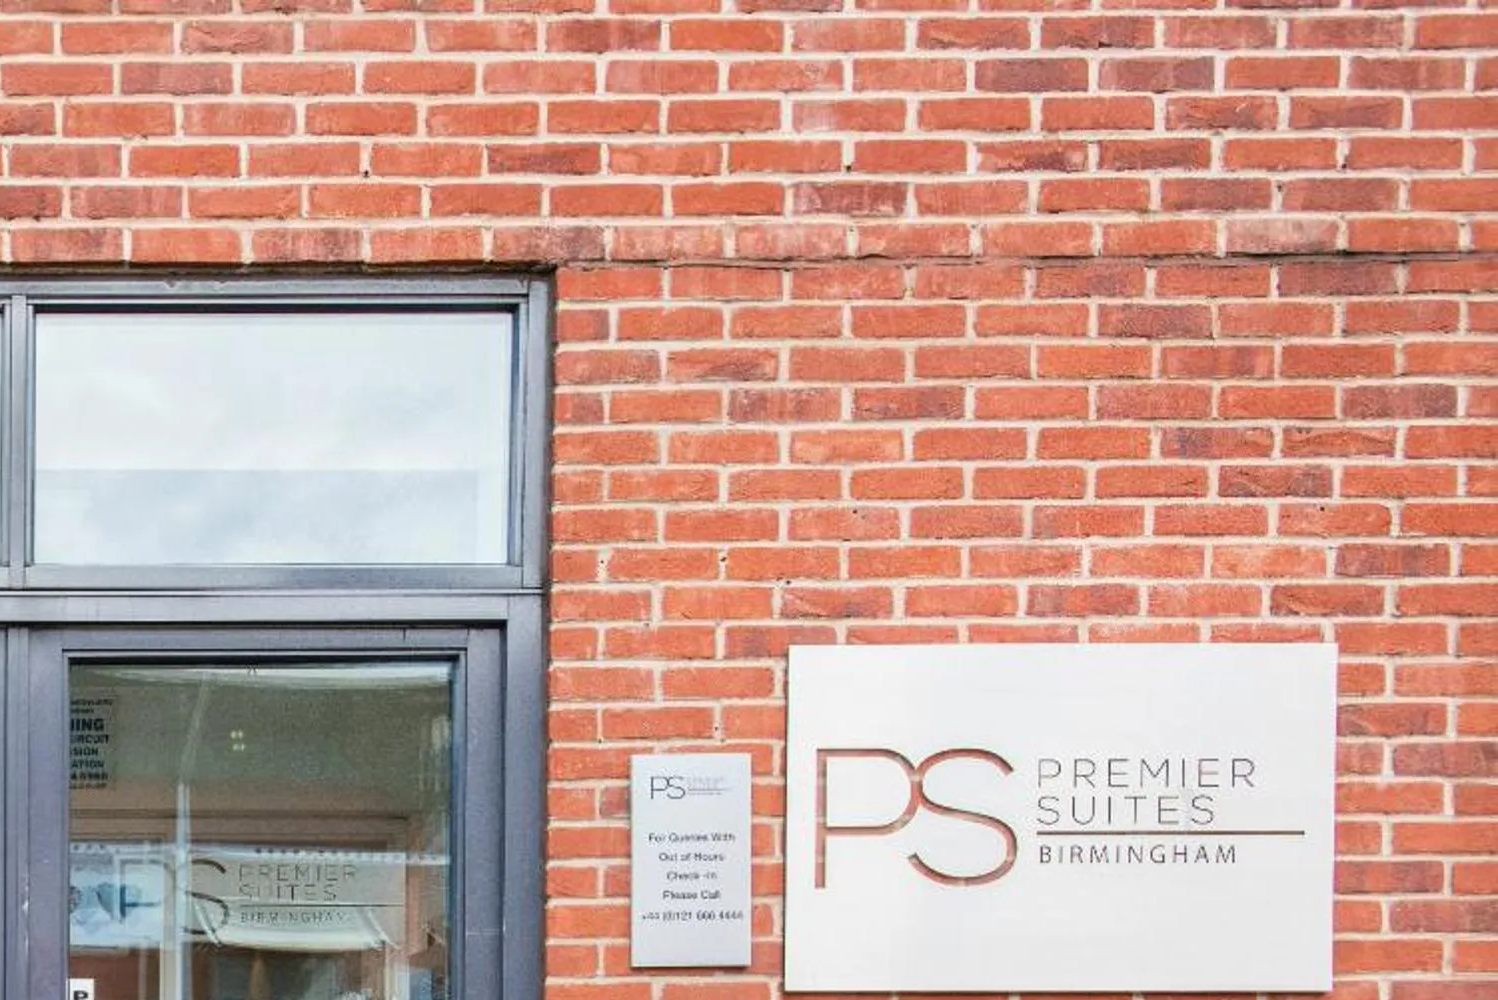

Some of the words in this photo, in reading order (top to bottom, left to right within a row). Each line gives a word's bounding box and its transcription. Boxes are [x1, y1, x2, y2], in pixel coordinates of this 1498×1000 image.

[1037, 757, 1256, 788] PREMIER
[650, 776, 686, 799] PS
[814, 747, 1018, 889] PS
[1036, 794, 1216, 826] SUITES
[648, 832, 665, 842] For
[711, 832, 736, 842] With
[658, 852, 678, 861] Out
[694, 852, 725, 861] Hours
[1038, 844, 1238, 864] BIRMINGHAM
[238, 862, 359, 882] PREMIER
[238, 883, 337, 902] SUITES
